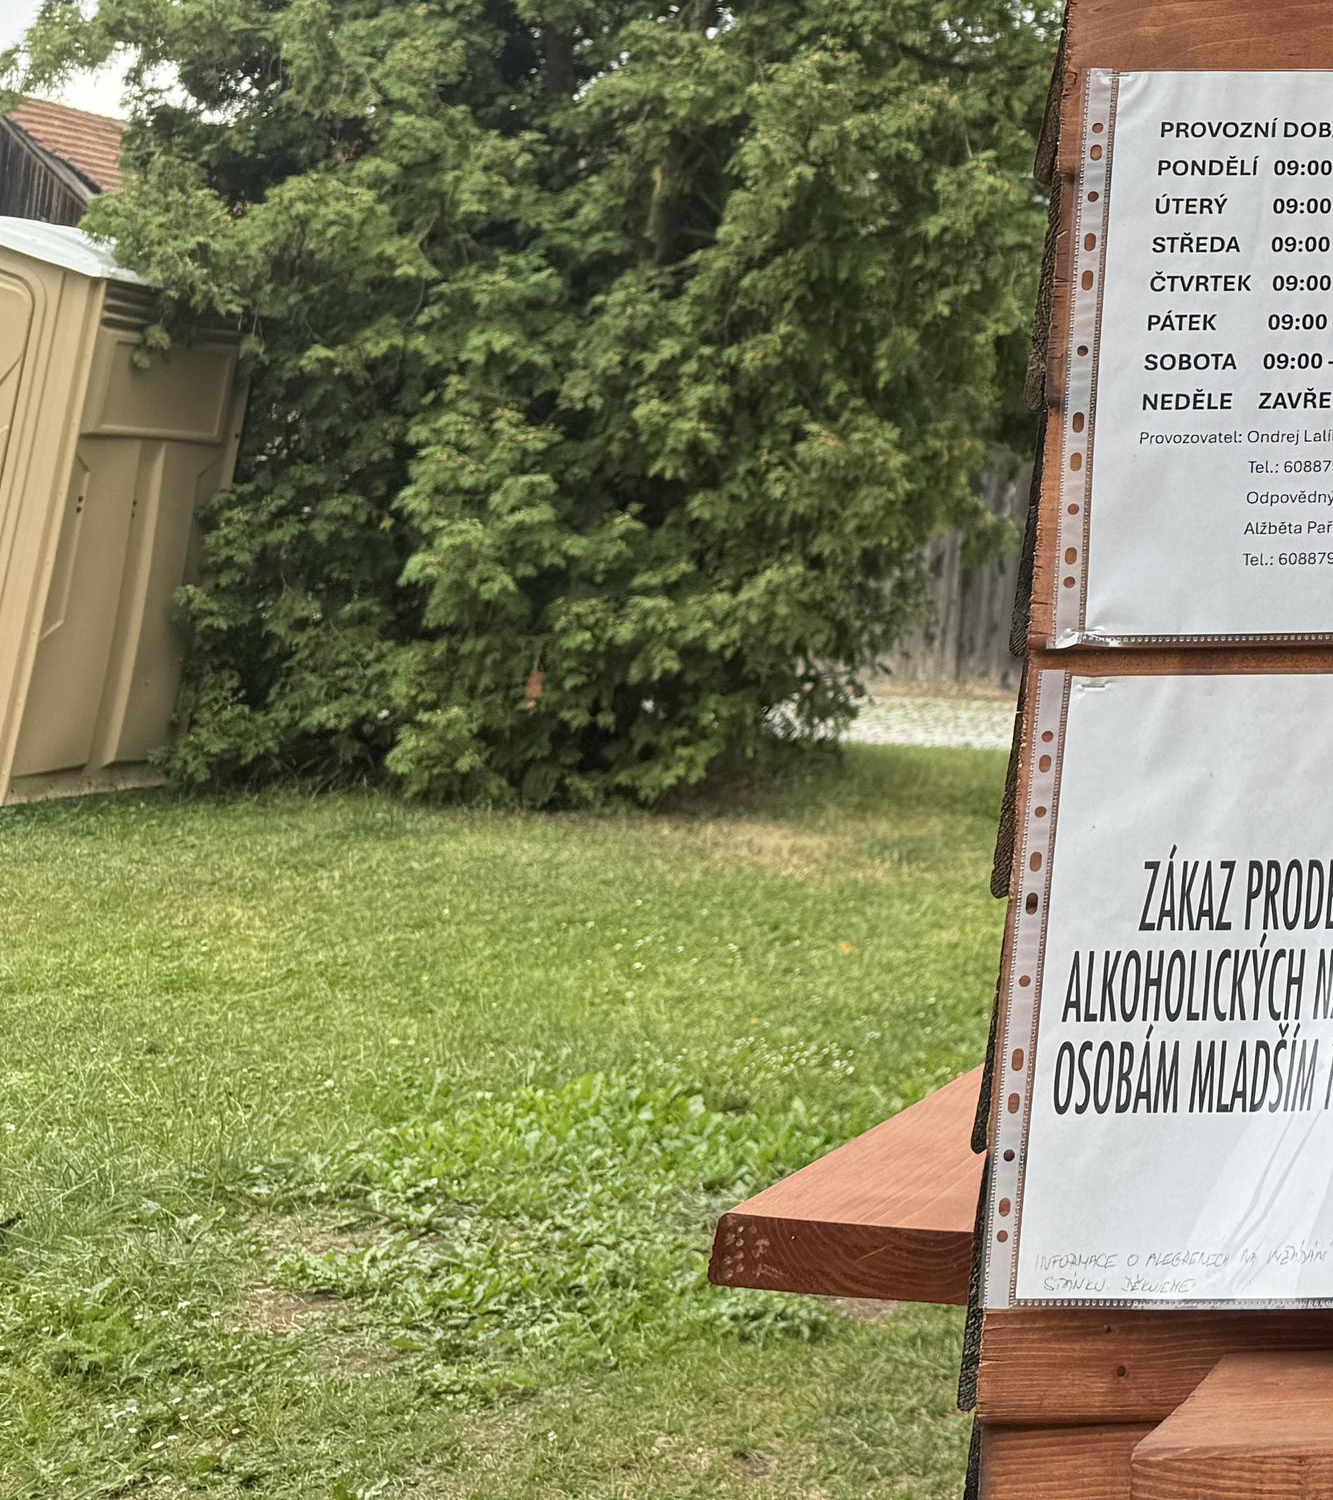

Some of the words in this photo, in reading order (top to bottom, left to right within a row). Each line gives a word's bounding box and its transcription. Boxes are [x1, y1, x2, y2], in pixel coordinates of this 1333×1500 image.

[1161, 117, 1278, 139] PROVOZNÍ
[1158, 156, 1259, 176] PONDĚLÍ
[1274, 160, 1332, 176] 09:00
[1155, 194, 1228, 215] ÚTERÝ
[1273, 198, 1331, 214] 09:00
[1152, 232, 1240, 253] STŘEDA
[1271, 236, 1330, 252] 09:00
[1149, 270, 1252, 292] ČTVRTEK
[1272, 275, 1331, 291] 09:00
[1147, 310, 1217, 331] PÁTEK
[1268, 314, 1327, 330] 09:00
[1144, 353, 1237, 371] SOBOTA
[1263, 353, 1323, 370] 09:00
[1142, 388, 1233, 411] NEDĚLE
[1139, 430, 1243, 445] Provozovatel:
[1247, 430, 1300, 445] Ondrej
[1248, 460, 1279, 474] Tel.:
[1244, 520, 1302, 536] Alžběta
[1243, 552, 1274, 566] Tel.:
[1138, 844, 1236, 931] ZÁKAZ
[1061, 932, 1306, 1022] ALKOHOLICKÝCH
[1053, 1024, 1180, 1115] OSOBÁM
[1189, 1022, 1320, 1113] MLADŠÍM
